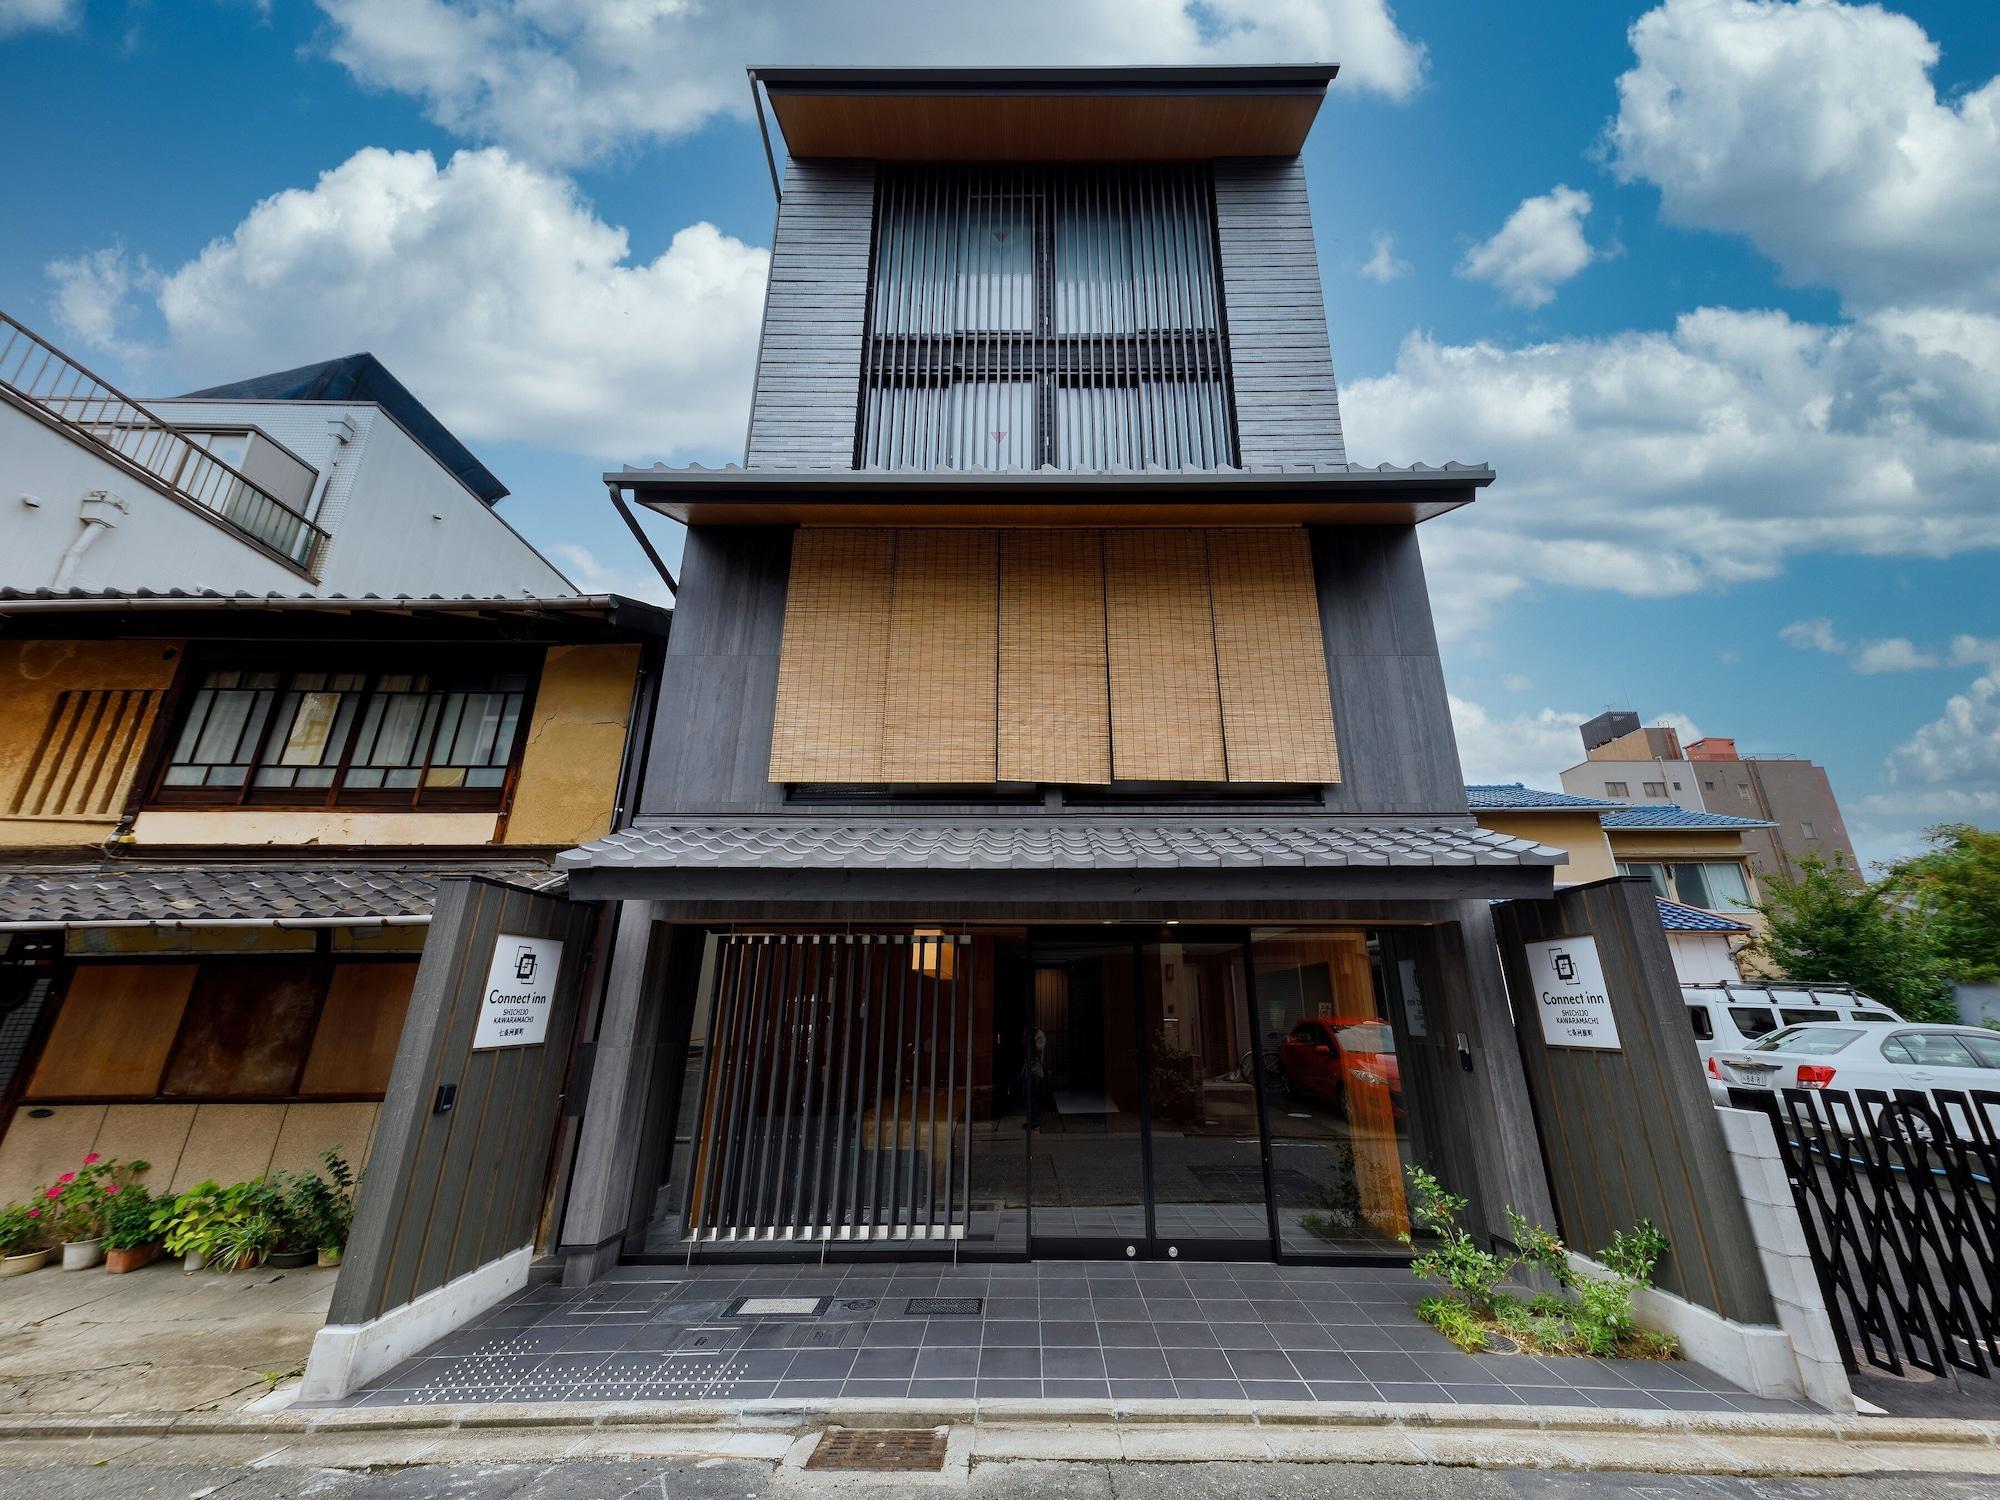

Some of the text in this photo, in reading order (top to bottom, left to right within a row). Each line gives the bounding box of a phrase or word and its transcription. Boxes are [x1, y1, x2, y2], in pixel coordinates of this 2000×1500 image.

[489, 989, 546, 1004] Connect inn
[1542, 991, 1605, 1006] Connect inn
[502, 1008, 529, 1016] SHICHIJO
[1561, 1009, 1589, 1018] SHICHIJO
[493, 1016, 534, 1024] KAWARAMACHI
[1555, 1017, 1600, 1025] KAWARAMACHI
